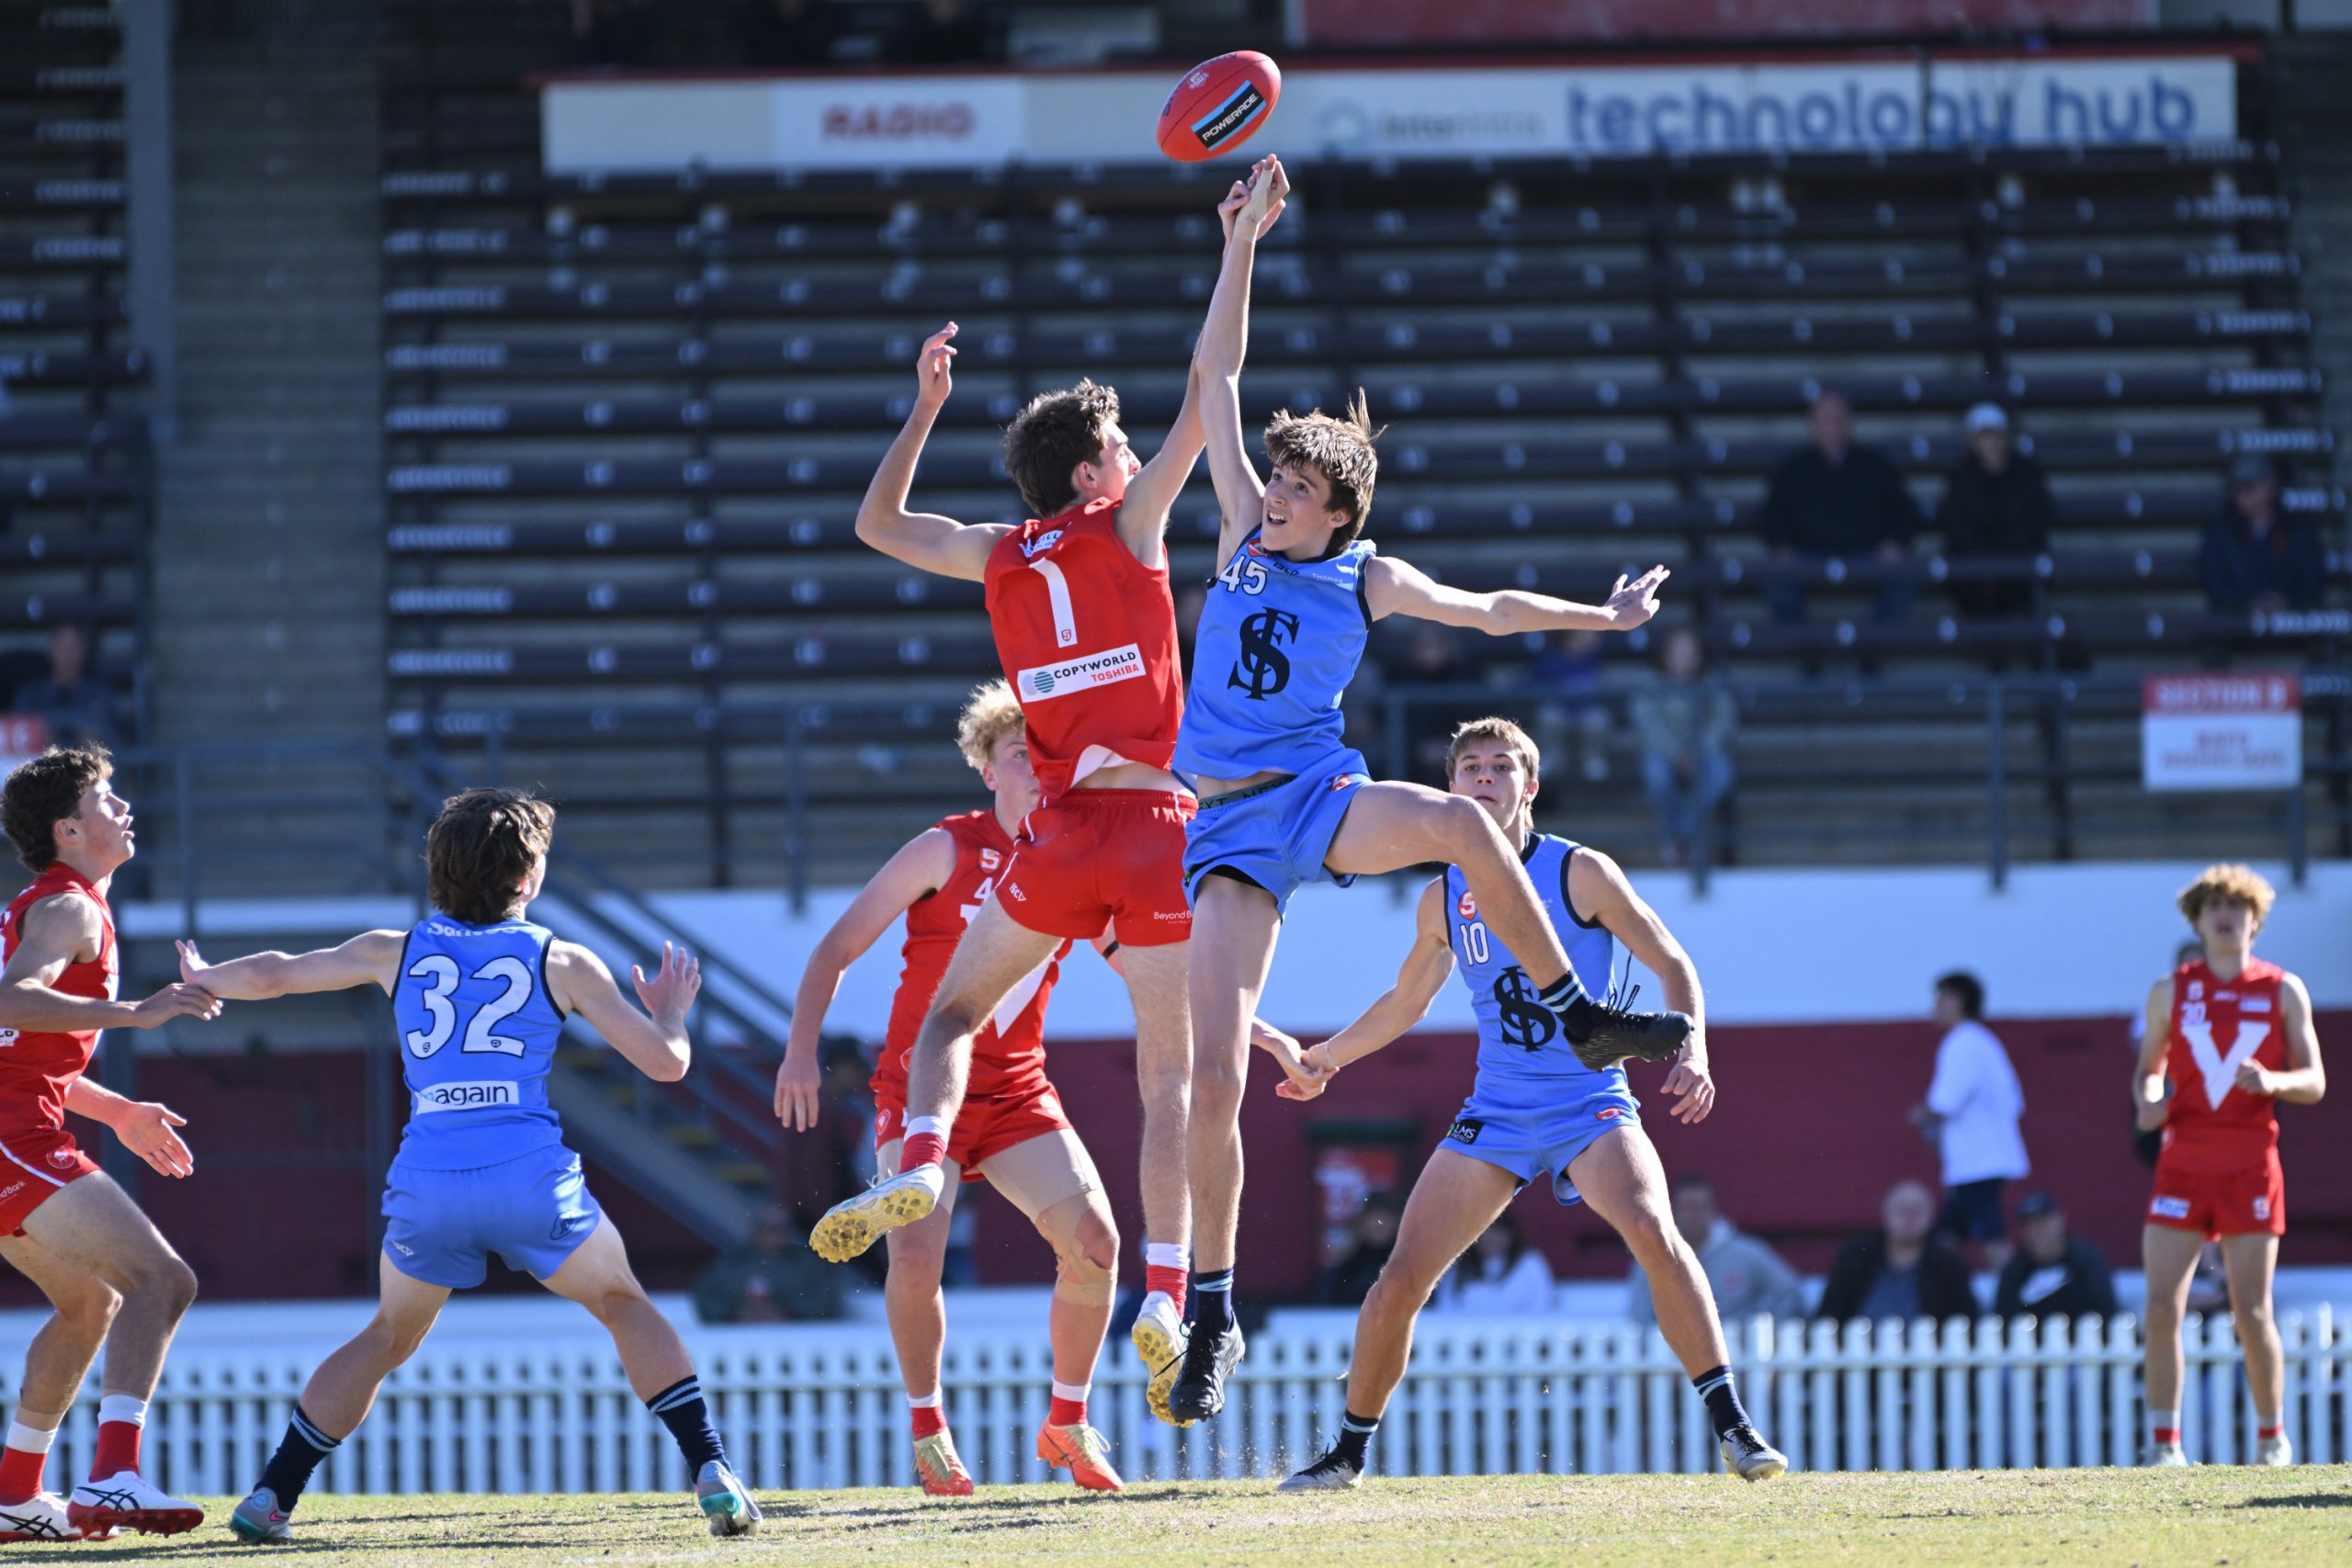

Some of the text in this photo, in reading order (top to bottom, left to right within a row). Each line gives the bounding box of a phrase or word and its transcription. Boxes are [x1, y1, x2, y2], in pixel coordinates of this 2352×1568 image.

[1202, 93, 1258, 141] POWERADE
[2045, 73, 2196, 142] hub
[1219, 554, 1271, 595] 45
[1311, 573, 1343, 584] THOMAS
[1054, 651, 1136, 679] COPYWORLD
[1091, 663, 1139, 682] TOSHIBA
[1154, 910, 1185, 920] Beyond
[1460, 920, 1489, 966] 10
[405, 953, 534, 1060] 32
[435, 1086, 508, 1106] again
[1454, 1123, 1476, 1139] LMS
